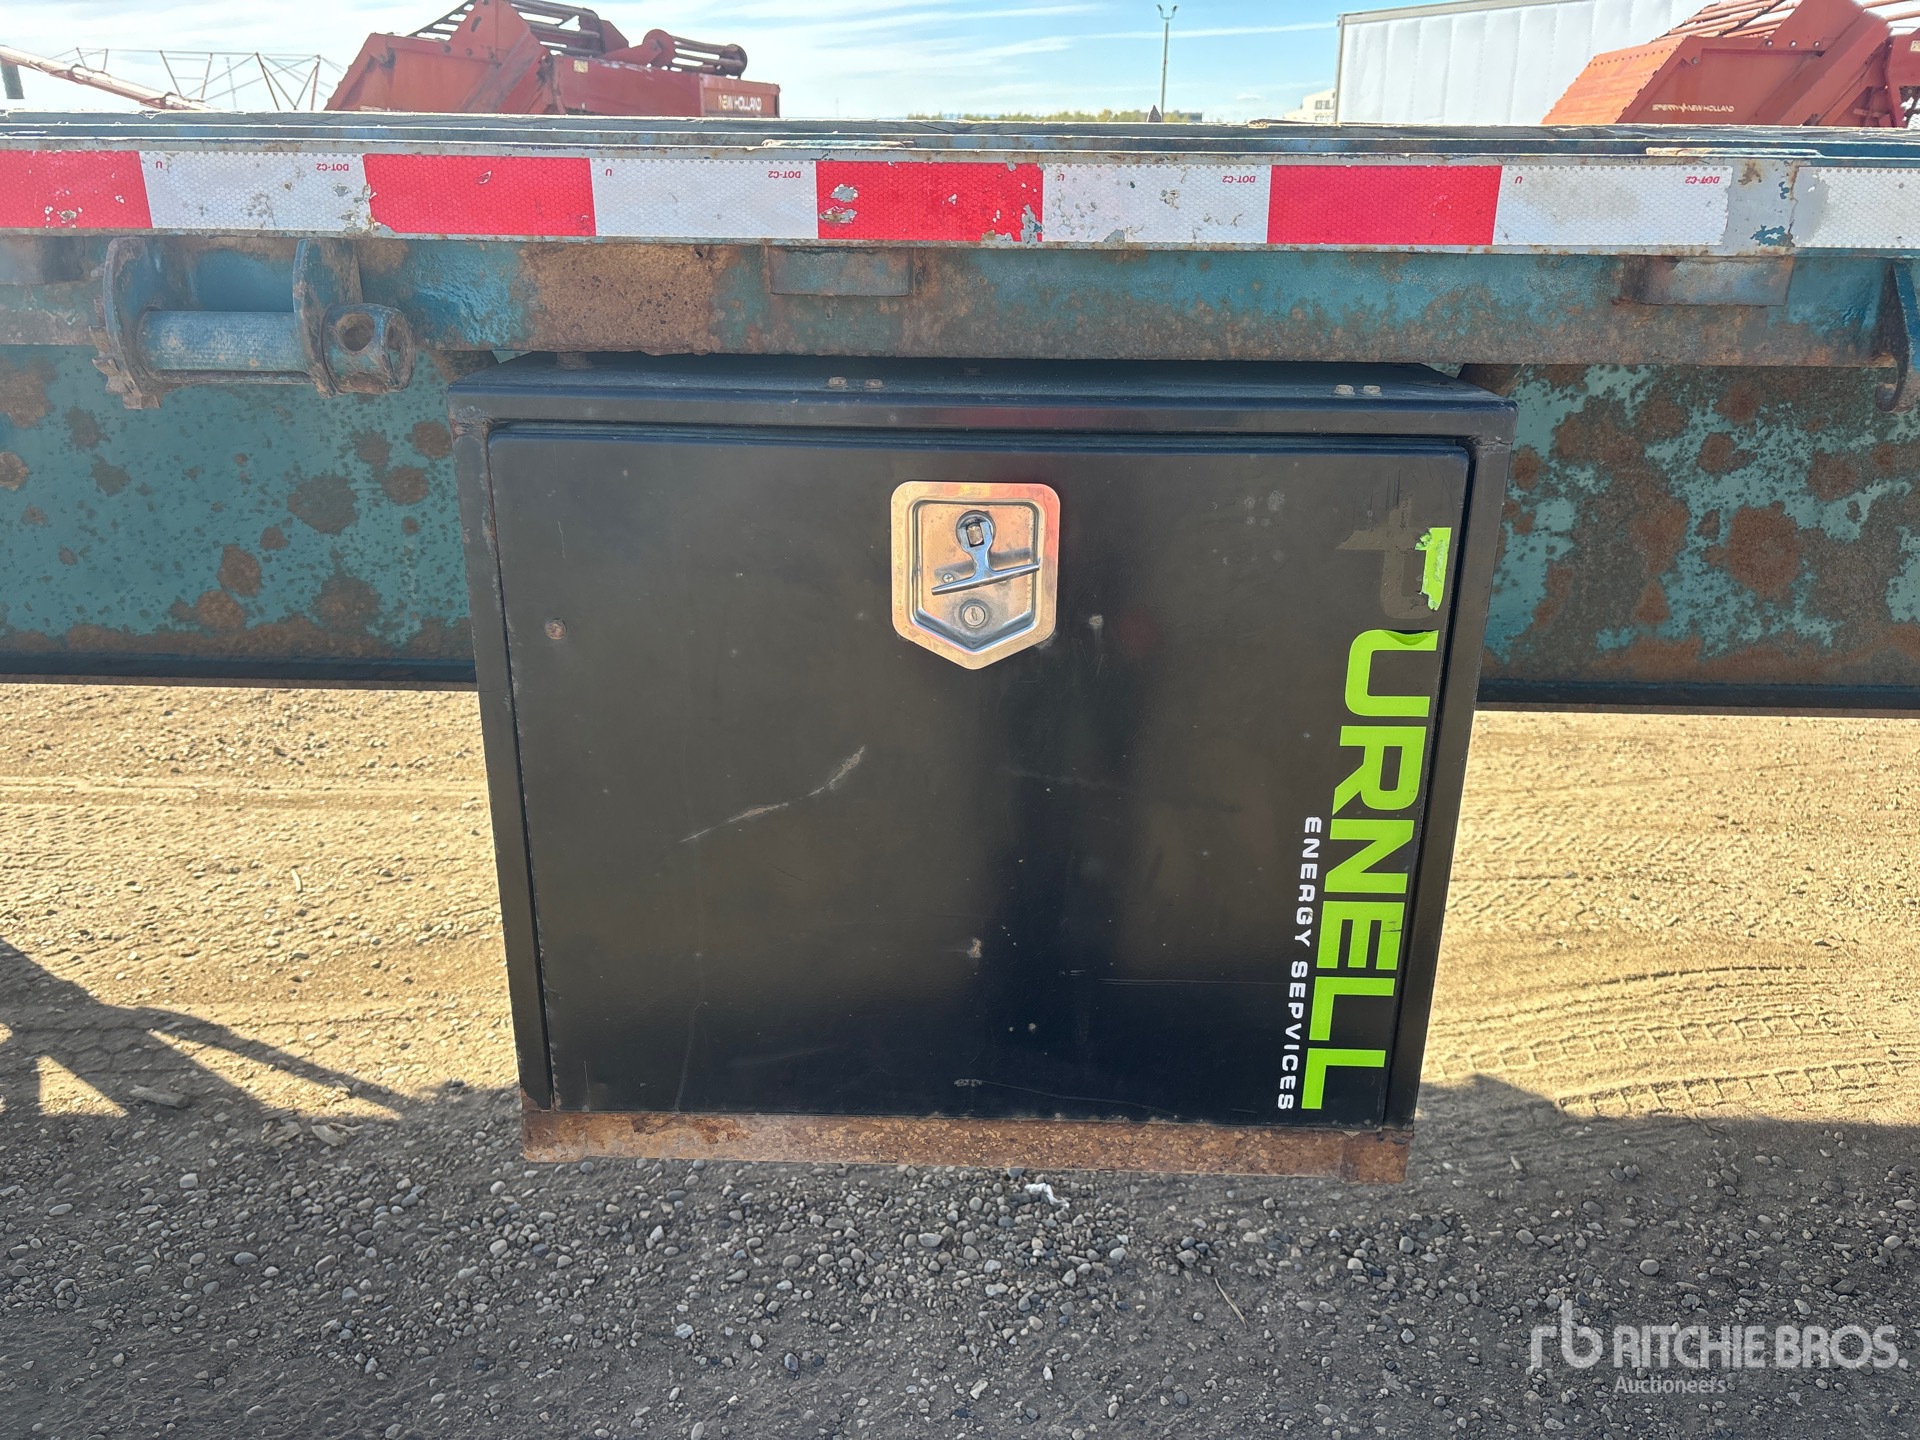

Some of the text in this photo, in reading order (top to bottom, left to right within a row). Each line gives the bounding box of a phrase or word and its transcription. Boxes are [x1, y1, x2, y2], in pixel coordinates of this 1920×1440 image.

[718, 94, 763, 112] NEW HOLLAND
[1703, 105, 1735, 113] HOLLAND
[316, 163, 350, 172] DOT-C2
[768, 170, 802, 179] DOT-C2
[1222, 175, 1256, 184] DOT-C2
[1685, 175, 1721, 184] DOT-C2
[1294, 816, 1323, 947] ENERGY
